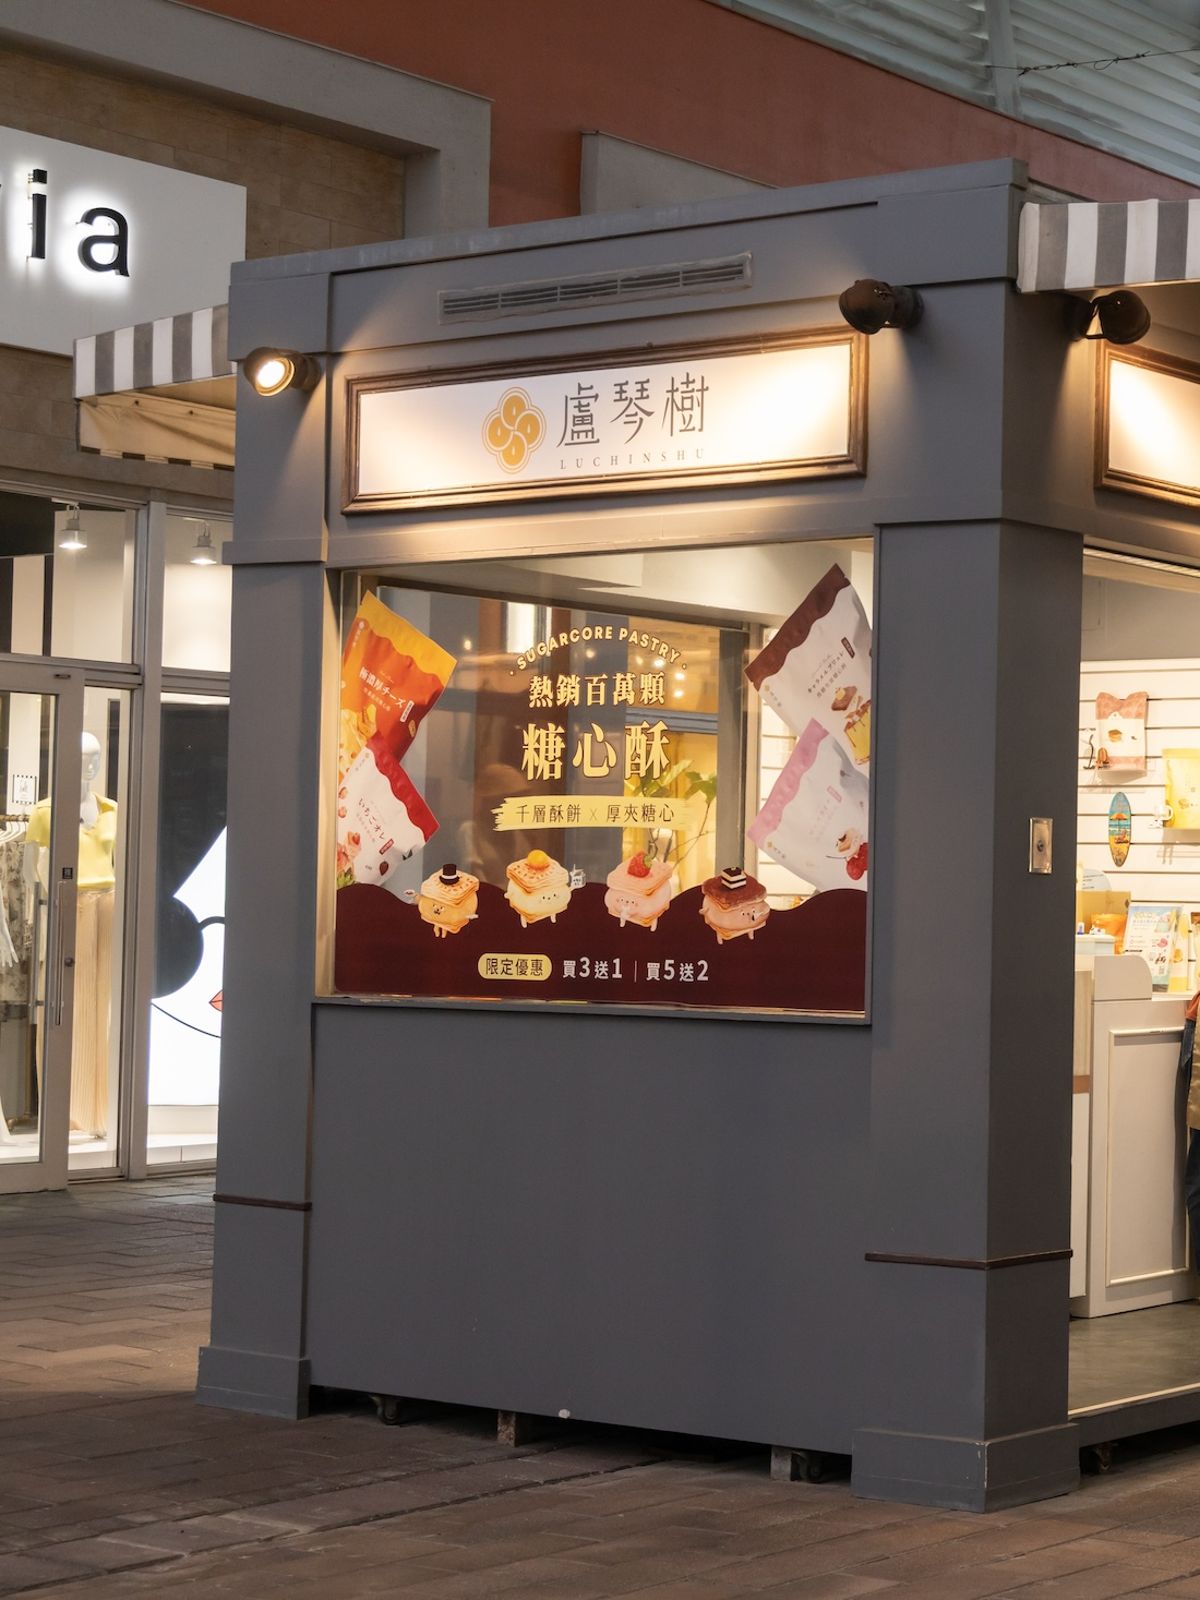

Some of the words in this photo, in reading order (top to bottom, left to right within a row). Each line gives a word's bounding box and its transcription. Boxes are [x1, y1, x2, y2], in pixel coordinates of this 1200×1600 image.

[0, 169, 130, 277] ia
[556, 372, 709, 449] 盧琴樹
[559, 448, 705, 470] LUCHINSHU
[516, 625, 613, 670] SUGARCORE
[618, 627, 682, 664] PASTRY
[528, 671, 666, 708] 熱銷百萬顆
[521, 720, 670, 781] 糖心酥
[516, 803, 582, 824] 千層酥餅
[606, 803, 675, 823] 厚夾糖心
[485, 957, 544, 977] 限定優惠
[562, 956, 623, 979] 買3送1
[646, 959, 709, 983] 買5送2
